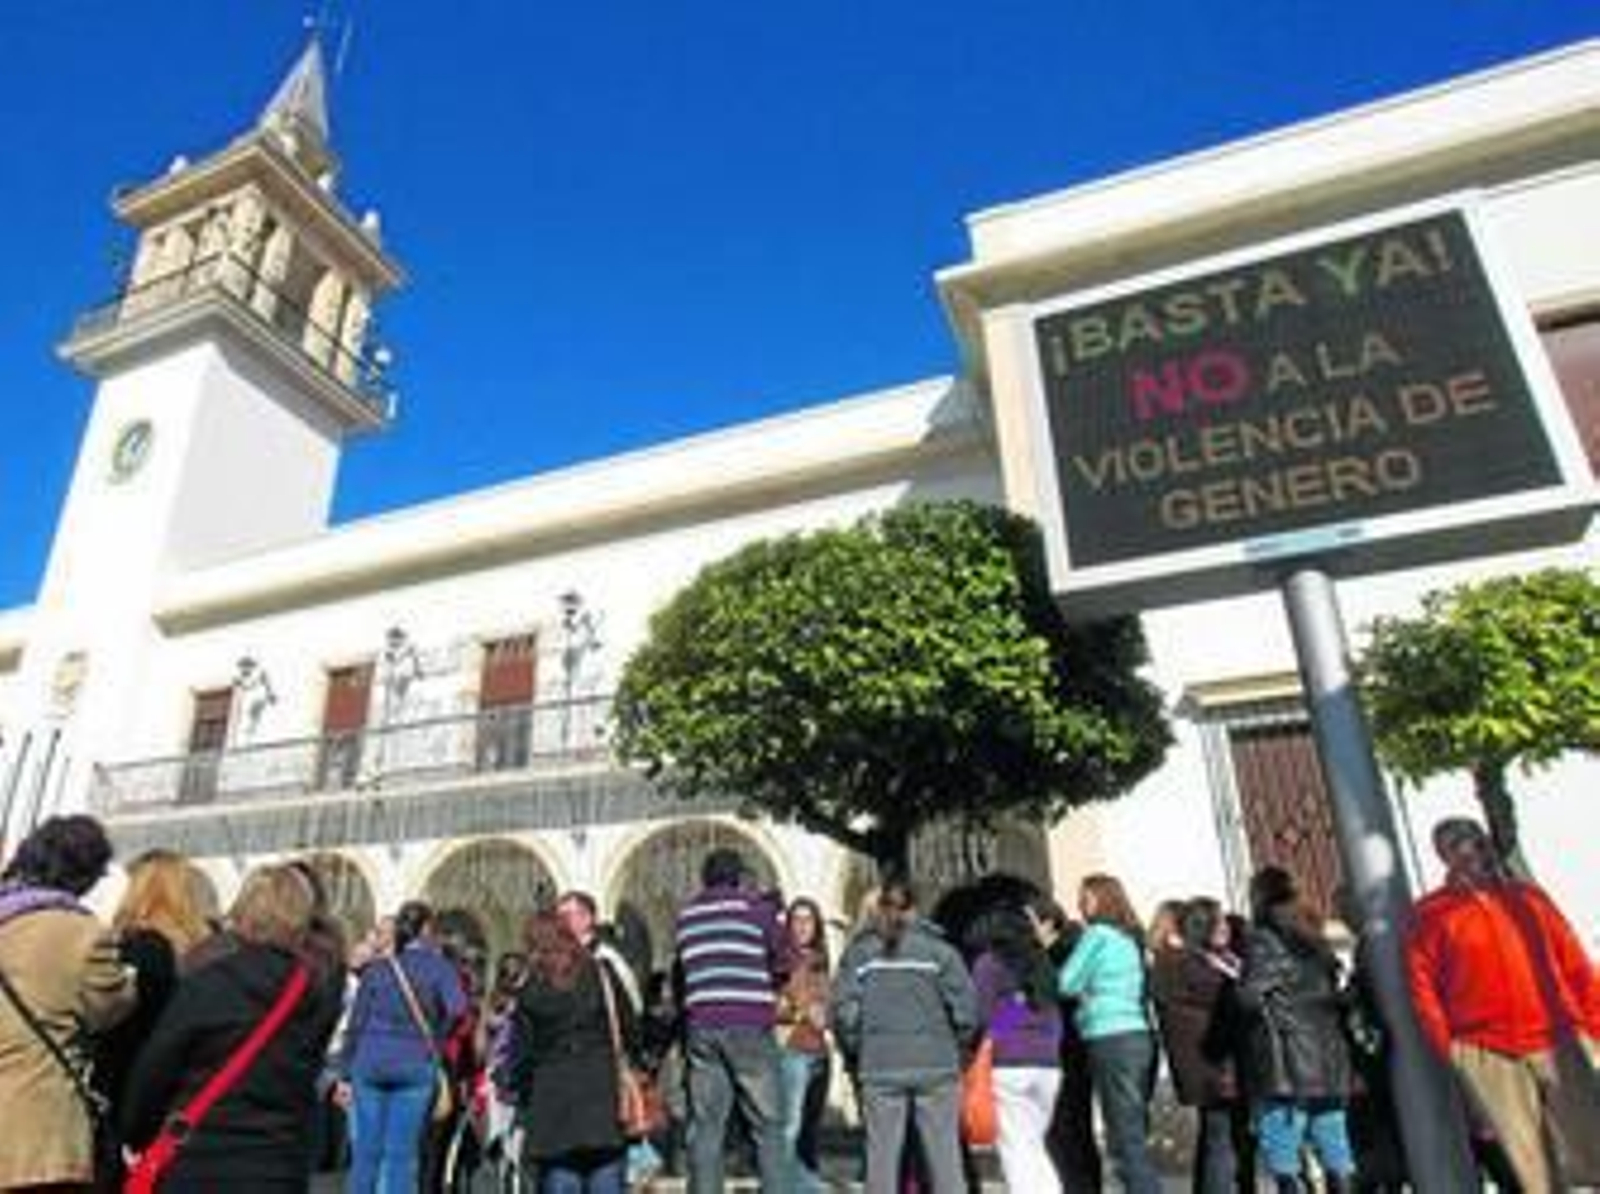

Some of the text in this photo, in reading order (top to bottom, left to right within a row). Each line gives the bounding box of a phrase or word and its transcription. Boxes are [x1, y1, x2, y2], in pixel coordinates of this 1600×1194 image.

[1050, 228, 1453, 376] ¡BASTA YA!
[1129, 331, 1403, 419] NO A LA
[1073, 372, 1496, 490] VIOLENCIA DE
[1160, 448, 1423, 530] GENERO
